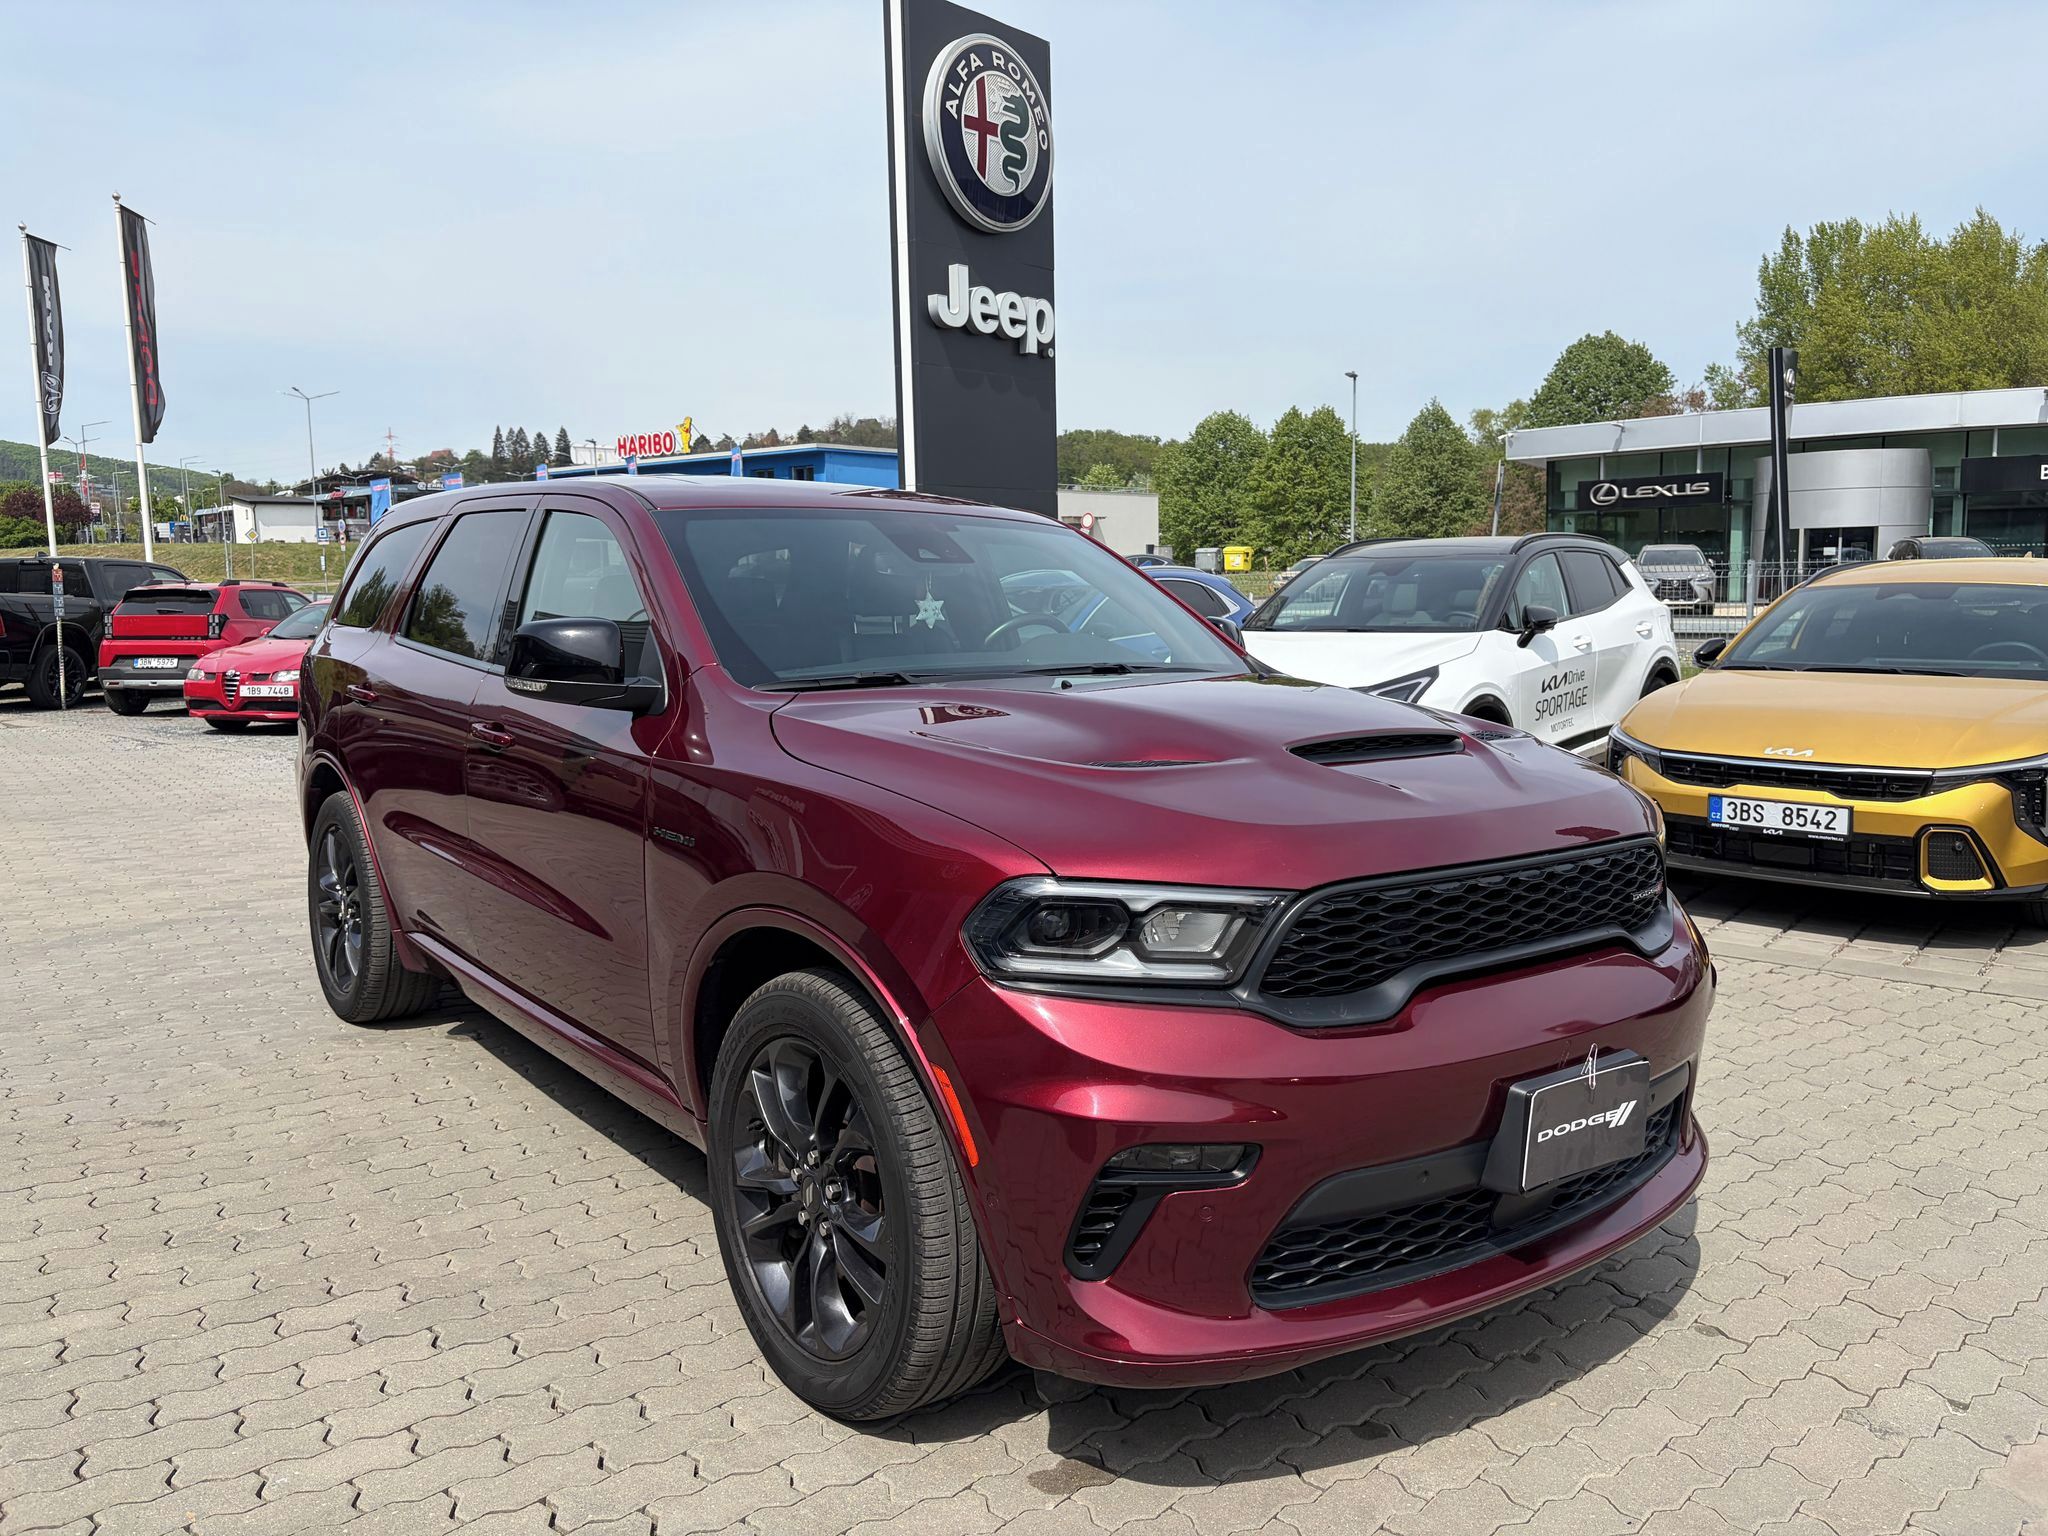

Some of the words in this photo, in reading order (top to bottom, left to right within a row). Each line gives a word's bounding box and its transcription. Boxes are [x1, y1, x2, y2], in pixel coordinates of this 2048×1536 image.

[945, 52, 984, 121] ALFA
[991, 50, 1048, 151] ROMEO
[928, 264, 1055, 355] Jeep
[616, 431, 674, 458] HARIBO
[1621, 481, 1710, 499] LEXUS
[267, 686, 290, 695] 7448
[1568, 668, 1586, 685] Drive
[1535, 686, 1588, 722] SPORTAGE
[1727, 801, 1765, 823] 3BS
[1781, 806, 1837, 831] 8542
[652, 826, 696, 848] HEMI
[1537, 1108, 1621, 1143] DODGE
